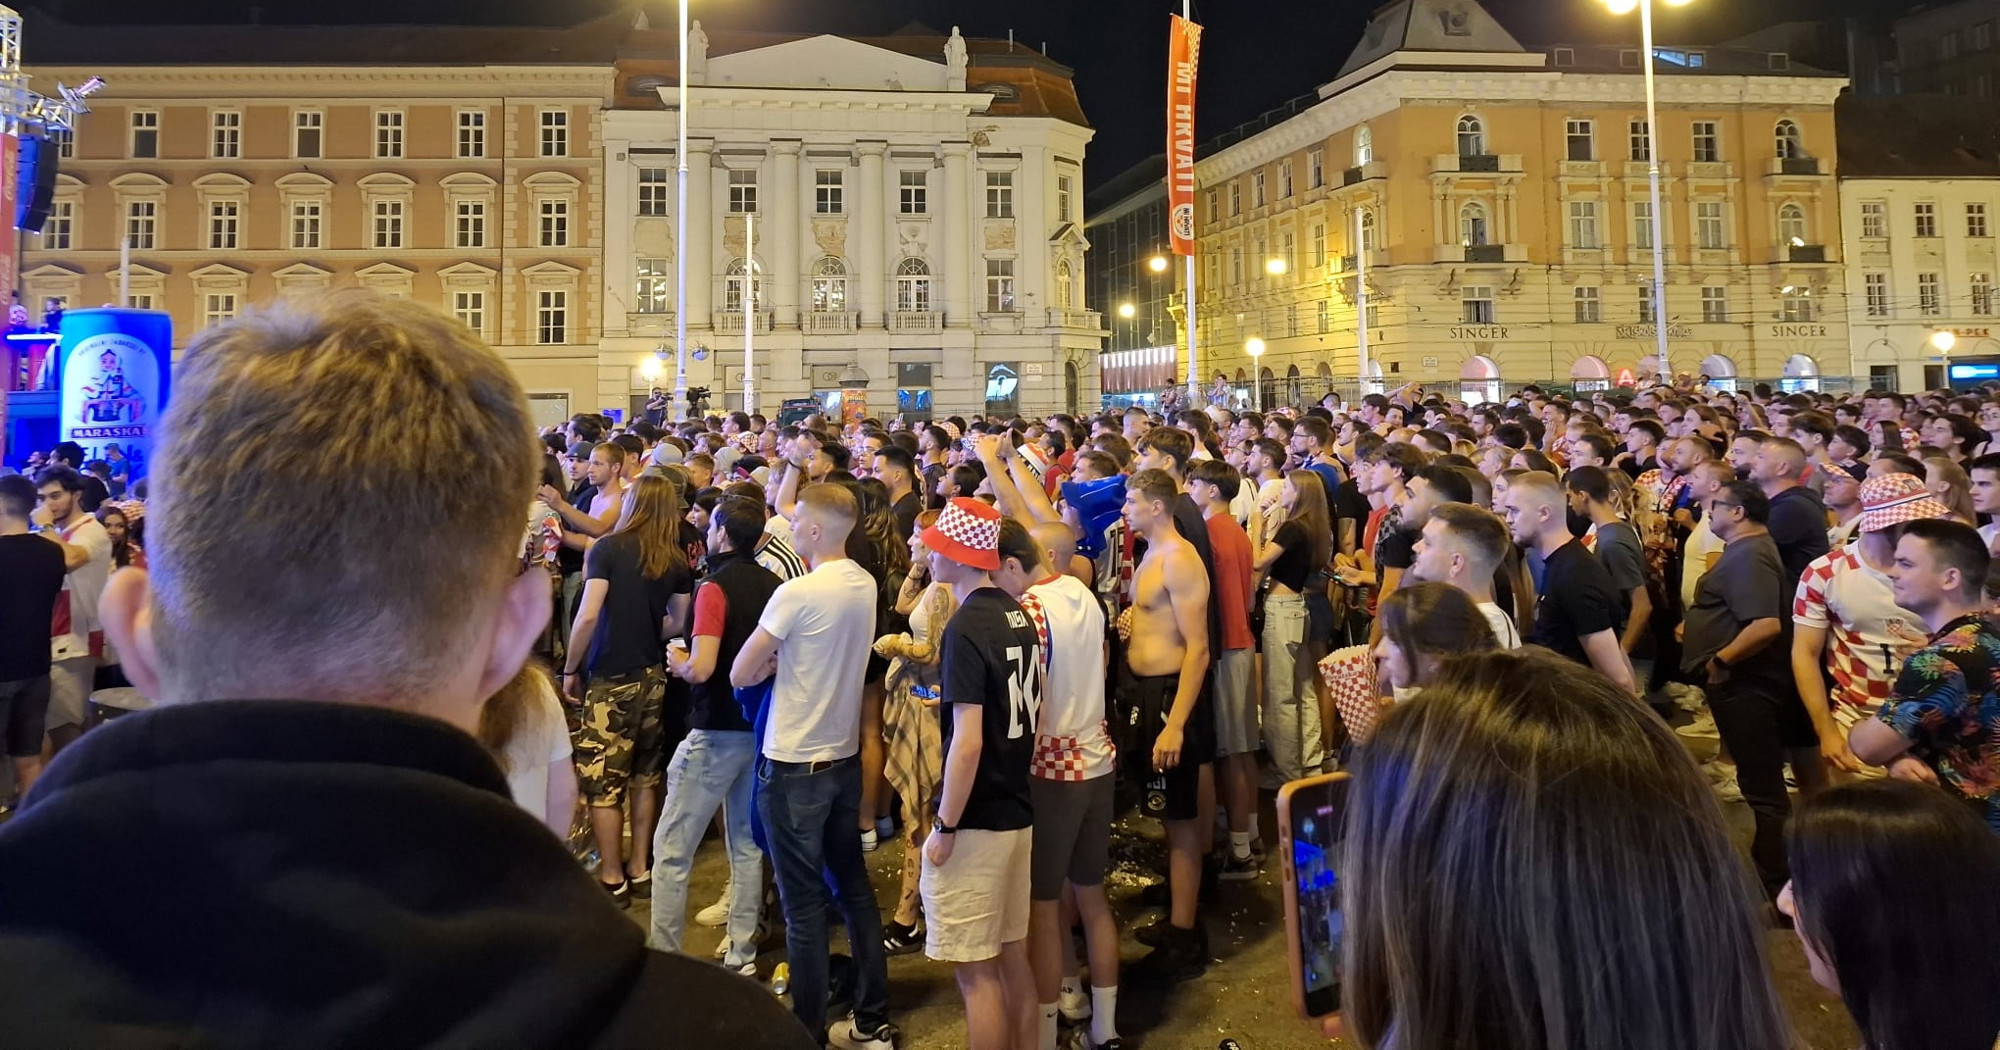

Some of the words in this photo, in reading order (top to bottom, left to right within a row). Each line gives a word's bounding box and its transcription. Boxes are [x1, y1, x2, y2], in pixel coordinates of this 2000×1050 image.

[1176, 62, 1191, 93] MI
[1450, 326, 1509, 339] SINGER
[1772, 325, 1827, 337] SINGER
[73, 427, 141, 437] MARASKA
